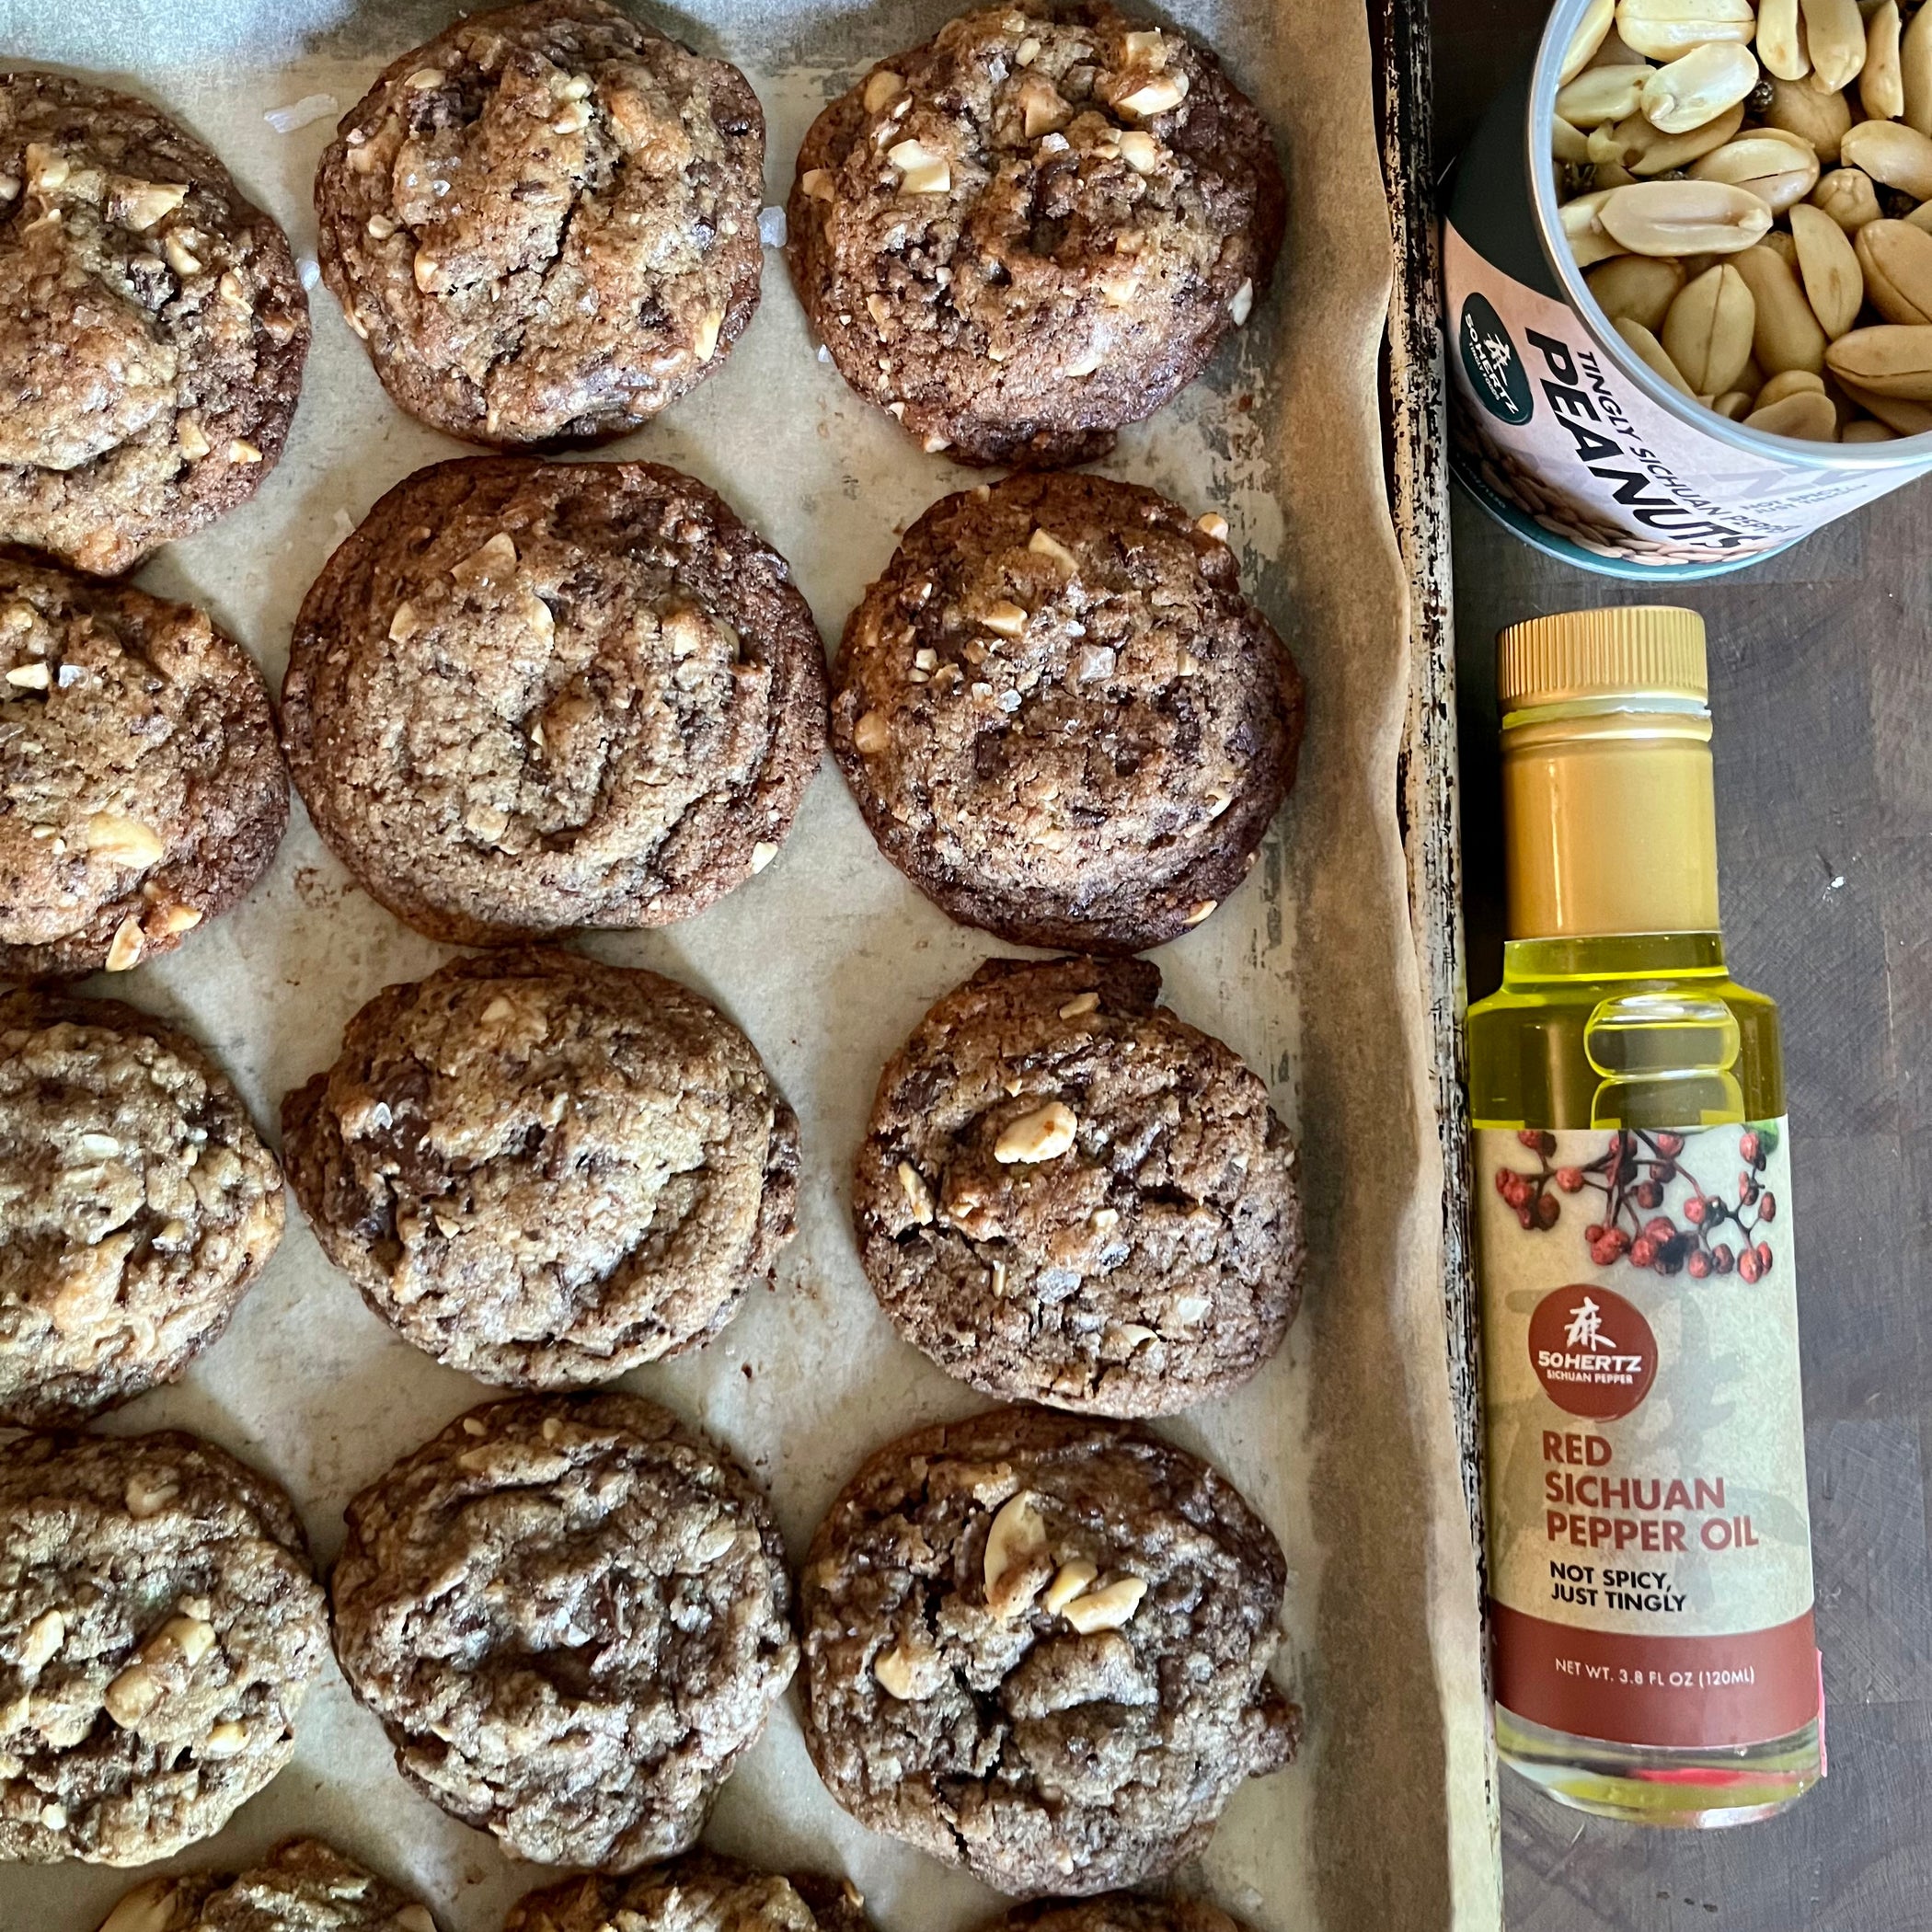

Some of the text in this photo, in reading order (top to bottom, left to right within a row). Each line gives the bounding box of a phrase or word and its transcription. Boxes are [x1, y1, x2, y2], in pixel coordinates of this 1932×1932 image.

[1524, 328, 1768, 548] PEANUTS
[1577, 351, 1643, 442] TINGLY
[1629, 446, 1732, 516] SICHUAN
[1538, 1350, 1642, 1372] 50HERTZ
[1547, 1369, 1634, 1385] SICHUAN PEPPER
[1542, 1431, 1612, 1466] RED
[1545, 1471, 1725, 1511] SICHUAN
[1546, 1510, 1759, 1552] PEPPER OIL
[1549, 1560, 1673, 1593] NOT SPICY,
[1551, 1582, 1687, 1613] JUST TINGLY
[1555, 1658, 1755, 1689] NET WT. 3.8 FL OZ (120ML)
